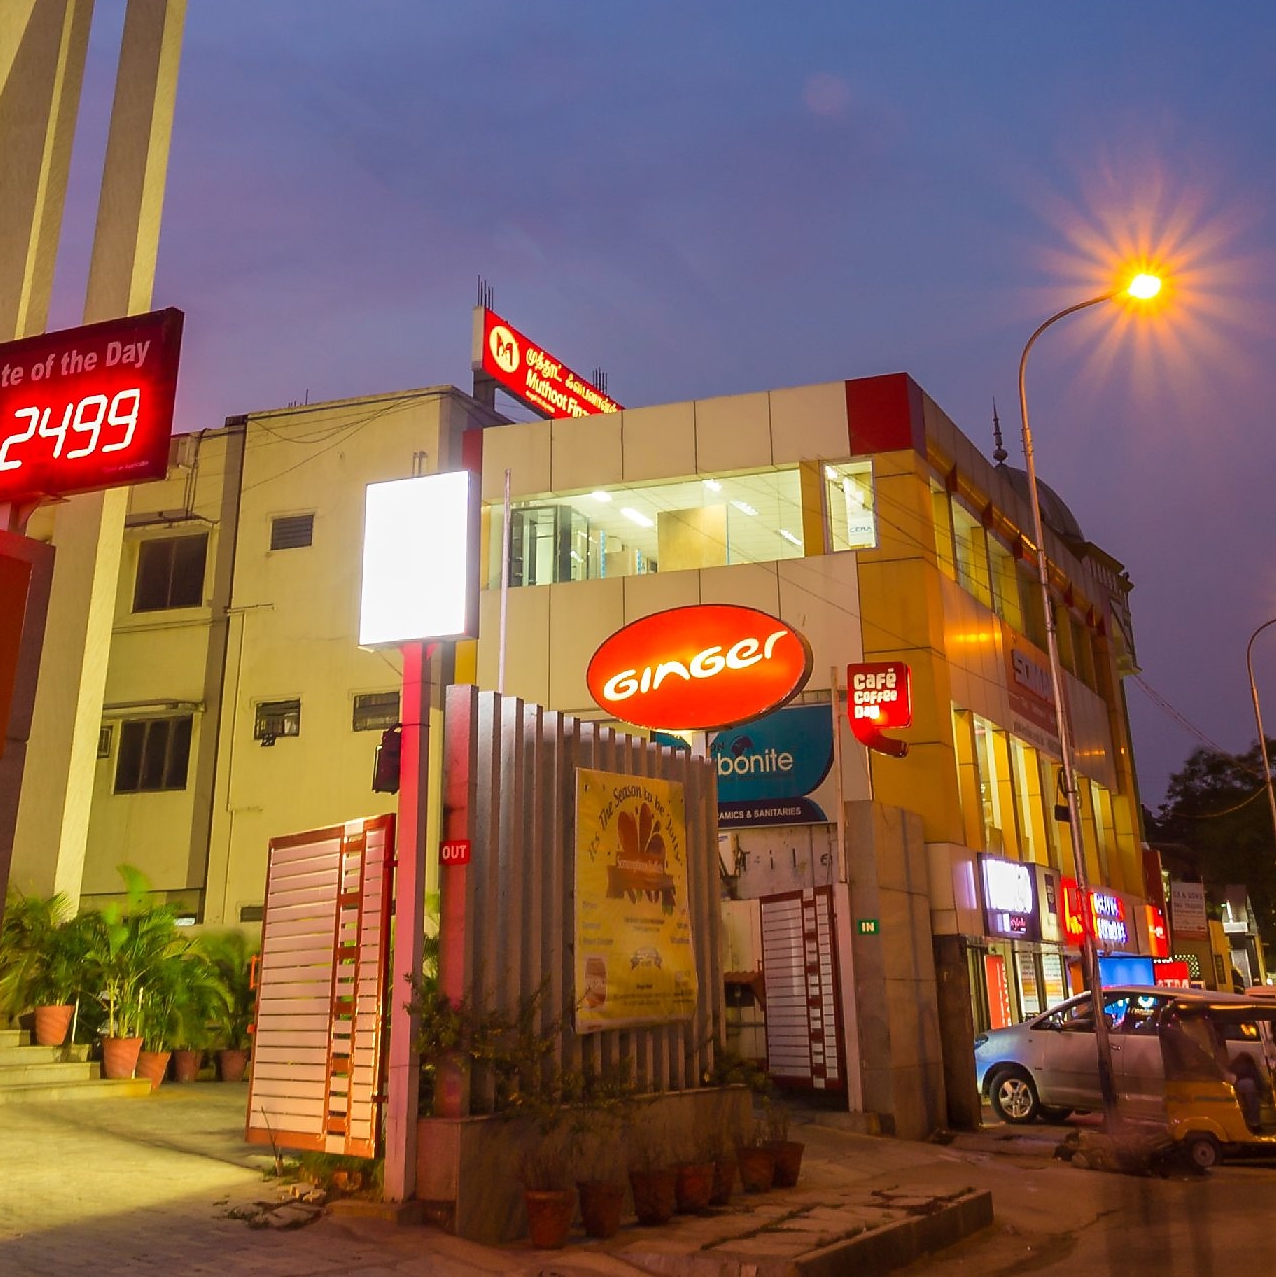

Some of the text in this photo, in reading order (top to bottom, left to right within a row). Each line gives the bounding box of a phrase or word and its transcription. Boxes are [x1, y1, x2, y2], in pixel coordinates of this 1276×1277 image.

[32, 354, 55, 381] of
[62, 349, 97, 375] the
[106, 339, 151, 369] Day
[526, 369, 568, 410] Muthoot
[854, 668, 897, 690] Café
[854, 690, 898, 705] Coffee
[854, 705, 880, 720] Day
[613, 785, 642, 808] Season
[644, 788, 653, 803] to
[655, 796, 665, 816] be
[718, 806, 802, 821] AMICS & SANITARIES
[442, 845, 467, 860] OUT
[862, 922, 875, 932] IN
